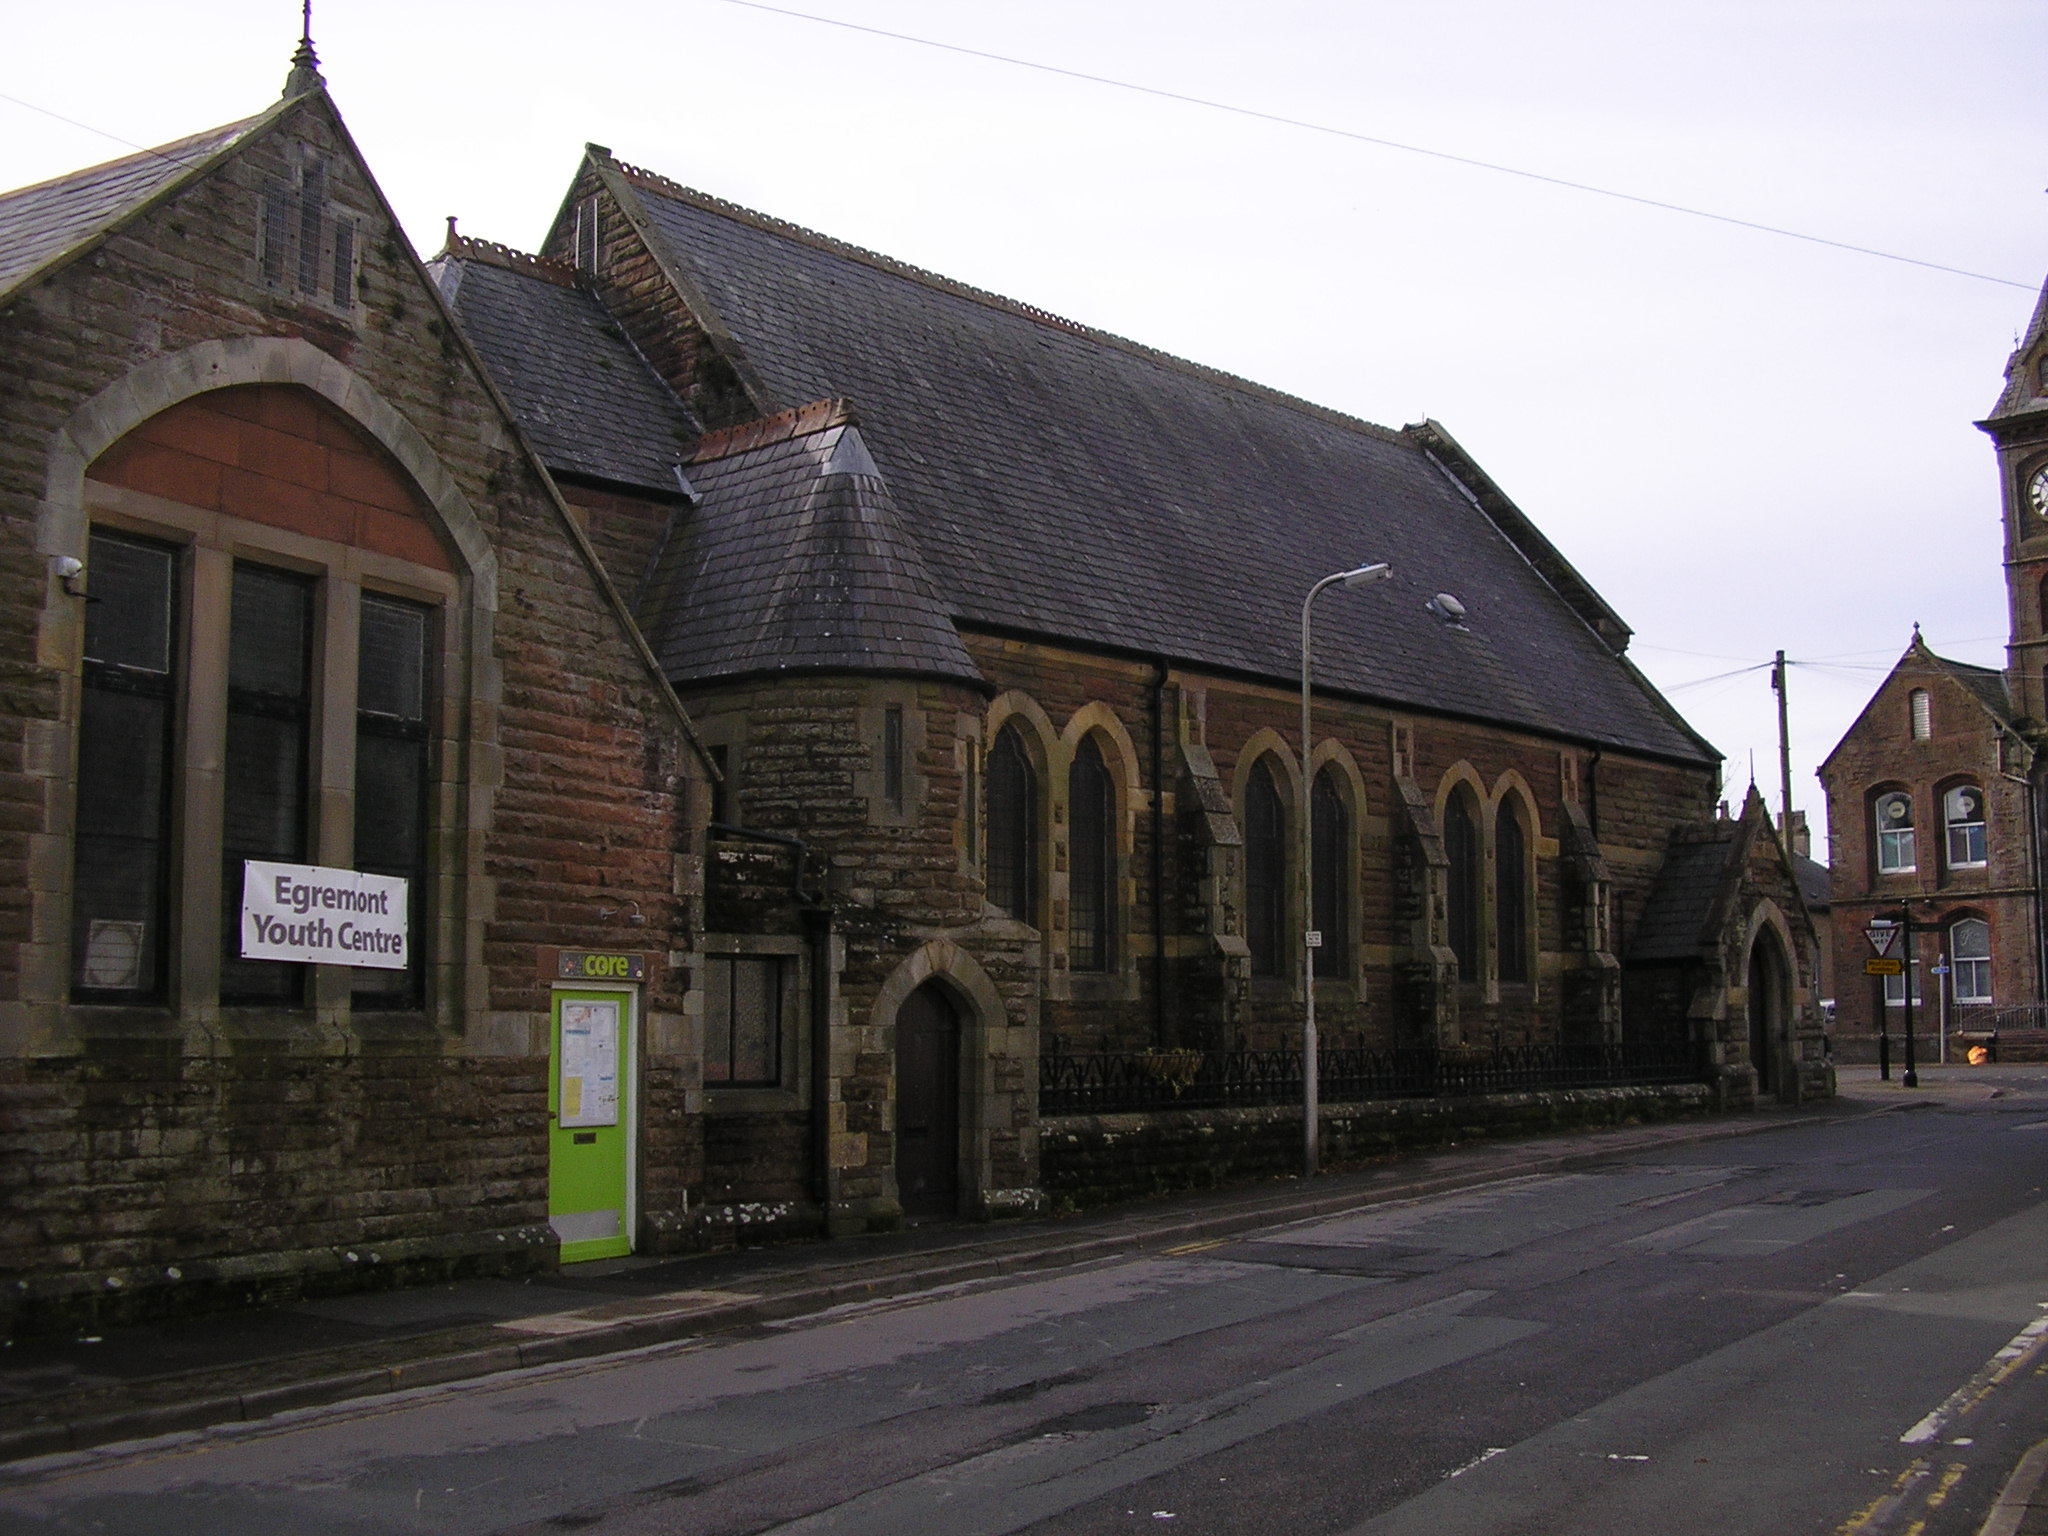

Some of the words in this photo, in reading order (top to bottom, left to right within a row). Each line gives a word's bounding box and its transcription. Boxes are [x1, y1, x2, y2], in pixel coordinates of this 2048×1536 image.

[275, 876, 388, 915] Egremont
[253, 913, 333, 949] Youth
[338, 921, 402, 955] Centre
[1869, 930, 1891, 938] GIVE
[585, 955, 629, 976] core
